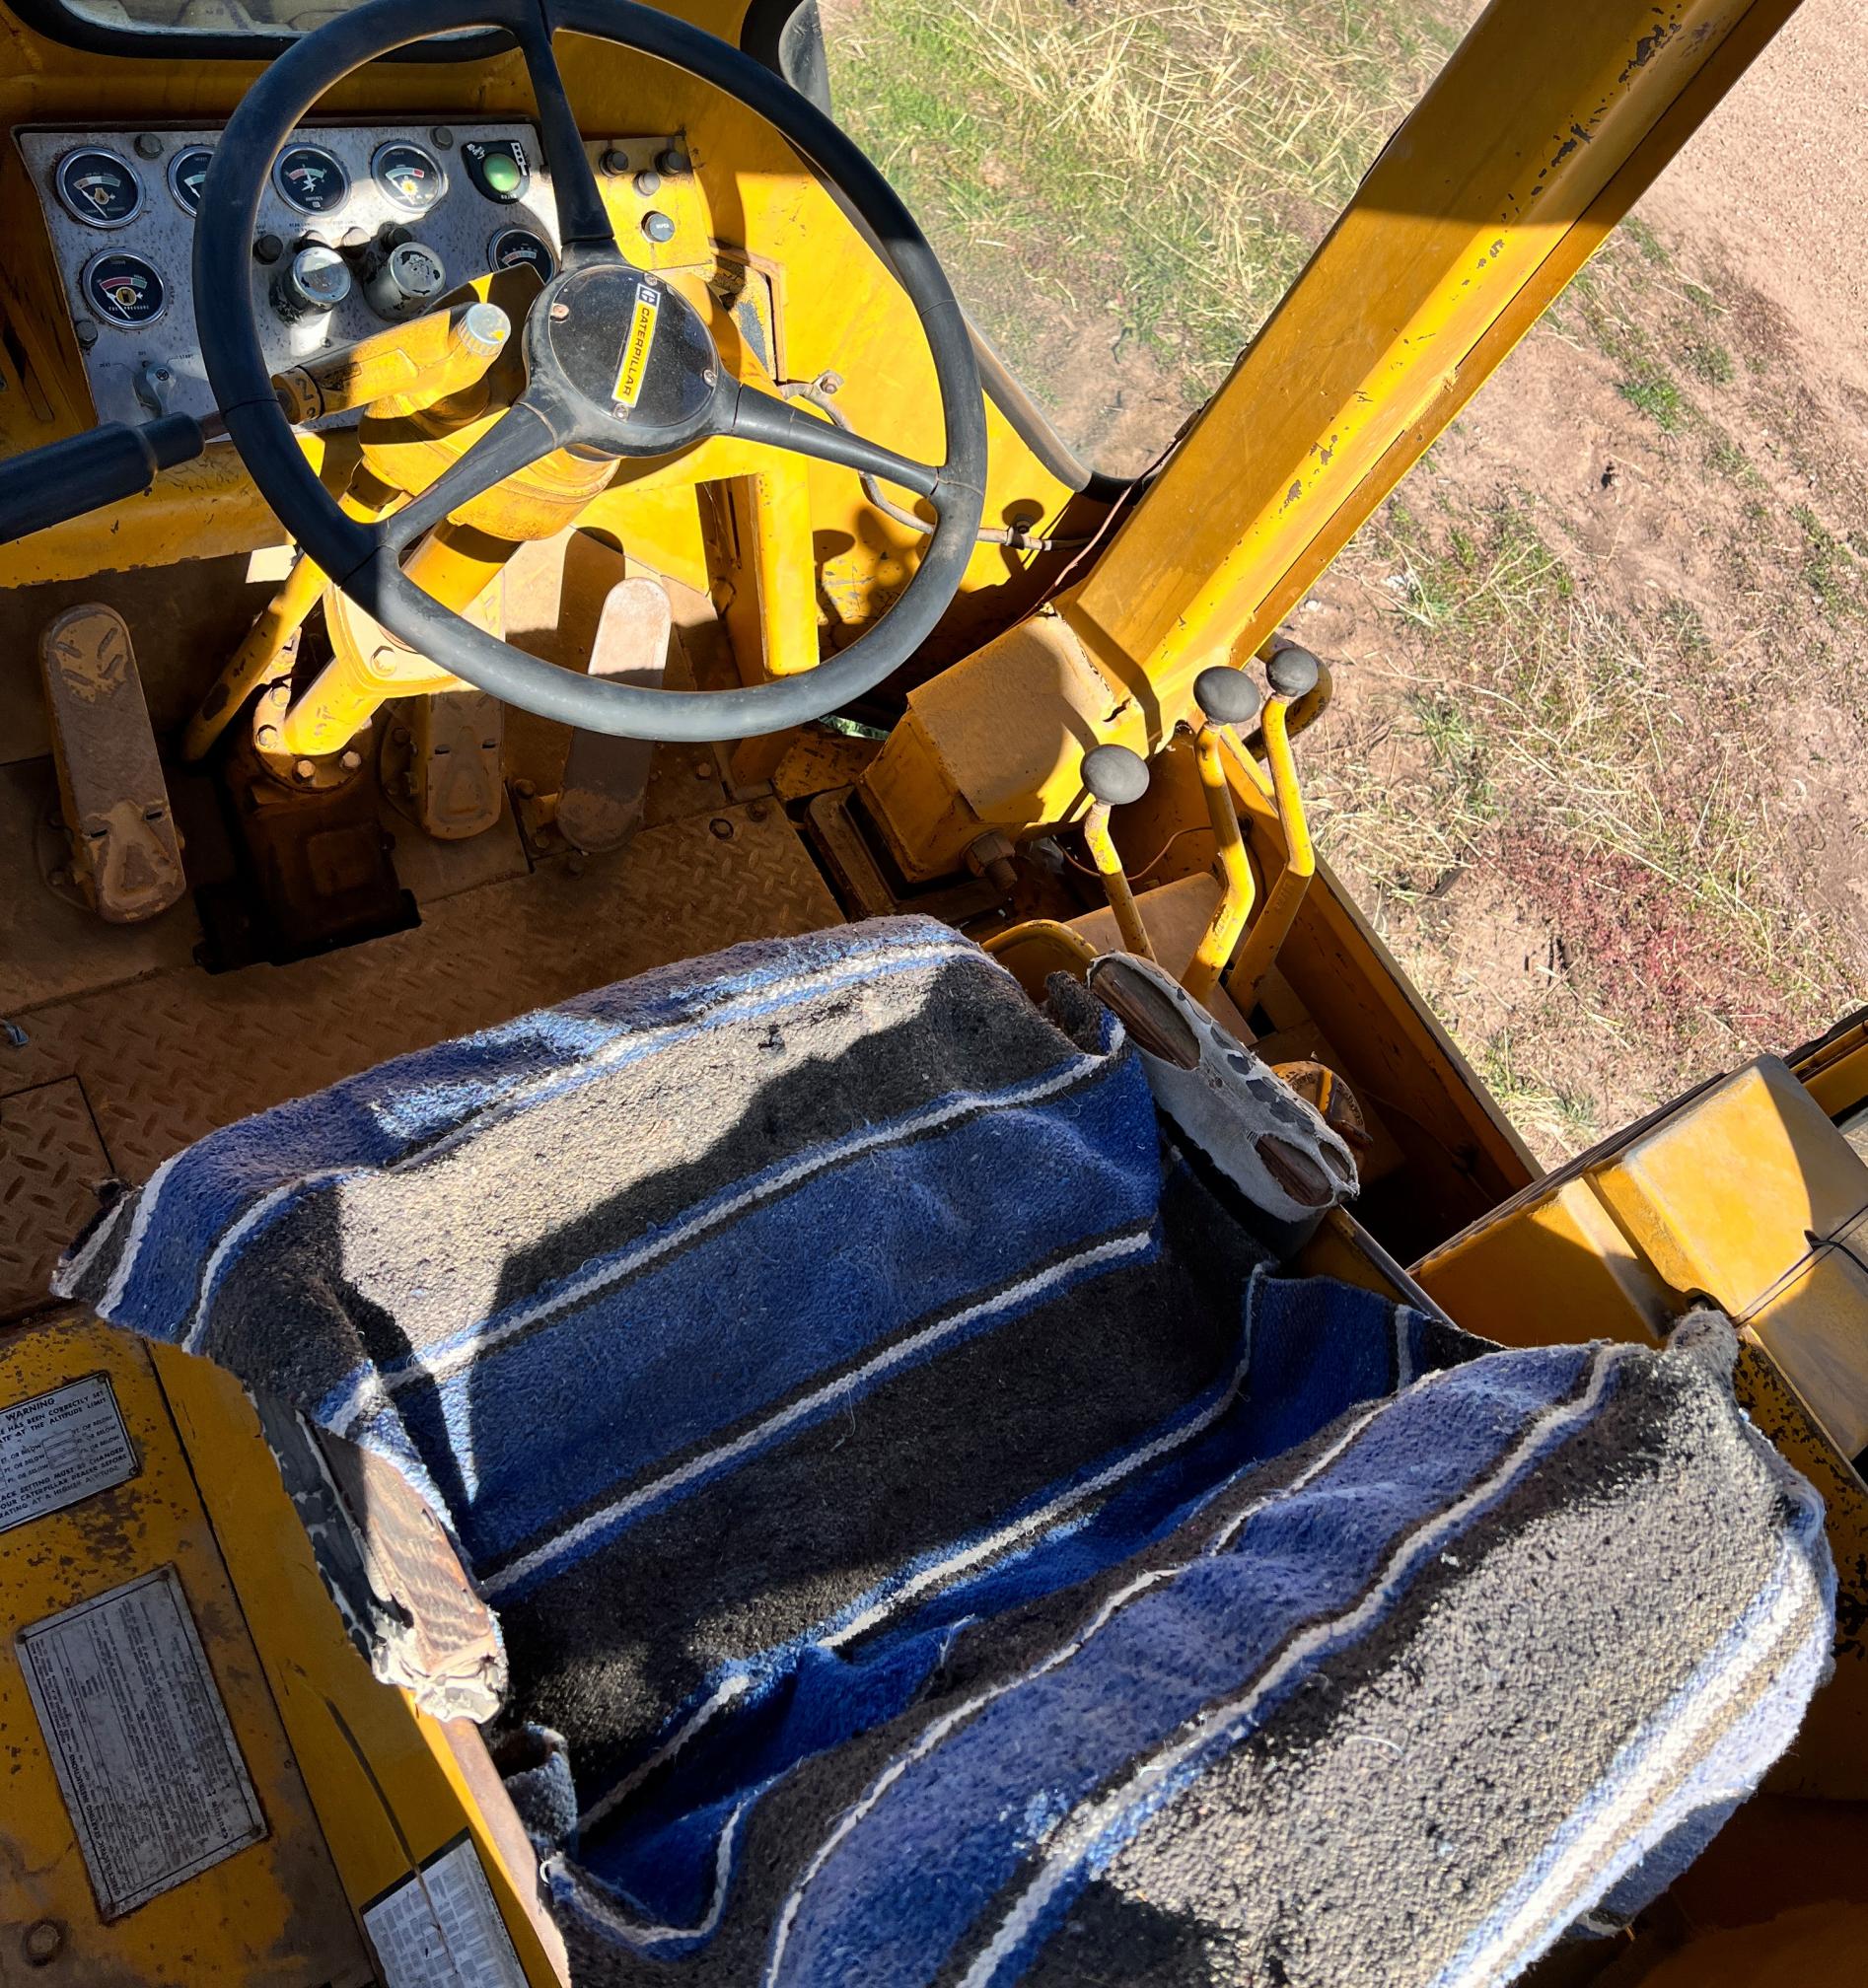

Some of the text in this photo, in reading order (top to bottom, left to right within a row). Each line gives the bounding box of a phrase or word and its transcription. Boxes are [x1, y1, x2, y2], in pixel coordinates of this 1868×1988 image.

[622, 307, 651, 397] CATERPILLAR
[5, 1397, 54, 1422] WARNING
[8, 1421, 23, 1432] HAS
[27, 1413, 44, 1425] BEEN
[48, 1396, 89, 1416] CORRECTLY
[31, 1422, 44, 1432] THE
[49, 1407, 83, 1424] ALTITUDE
[86, 1397, 107, 1409] LIMIT
[20, 1476, 50, 1494] SETTING
[53, 1467, 73, 1480] MUST
[89, 1446, 124, 1465] CHANGED
[20, 1477, 68, 1503] CATERPILLAR
[71, 1464, 98, 1481] DEALER
[100, 1454, 126, 1468] BEFORE
[67, 1751, 90, 1805] INSTRUCTIONS
